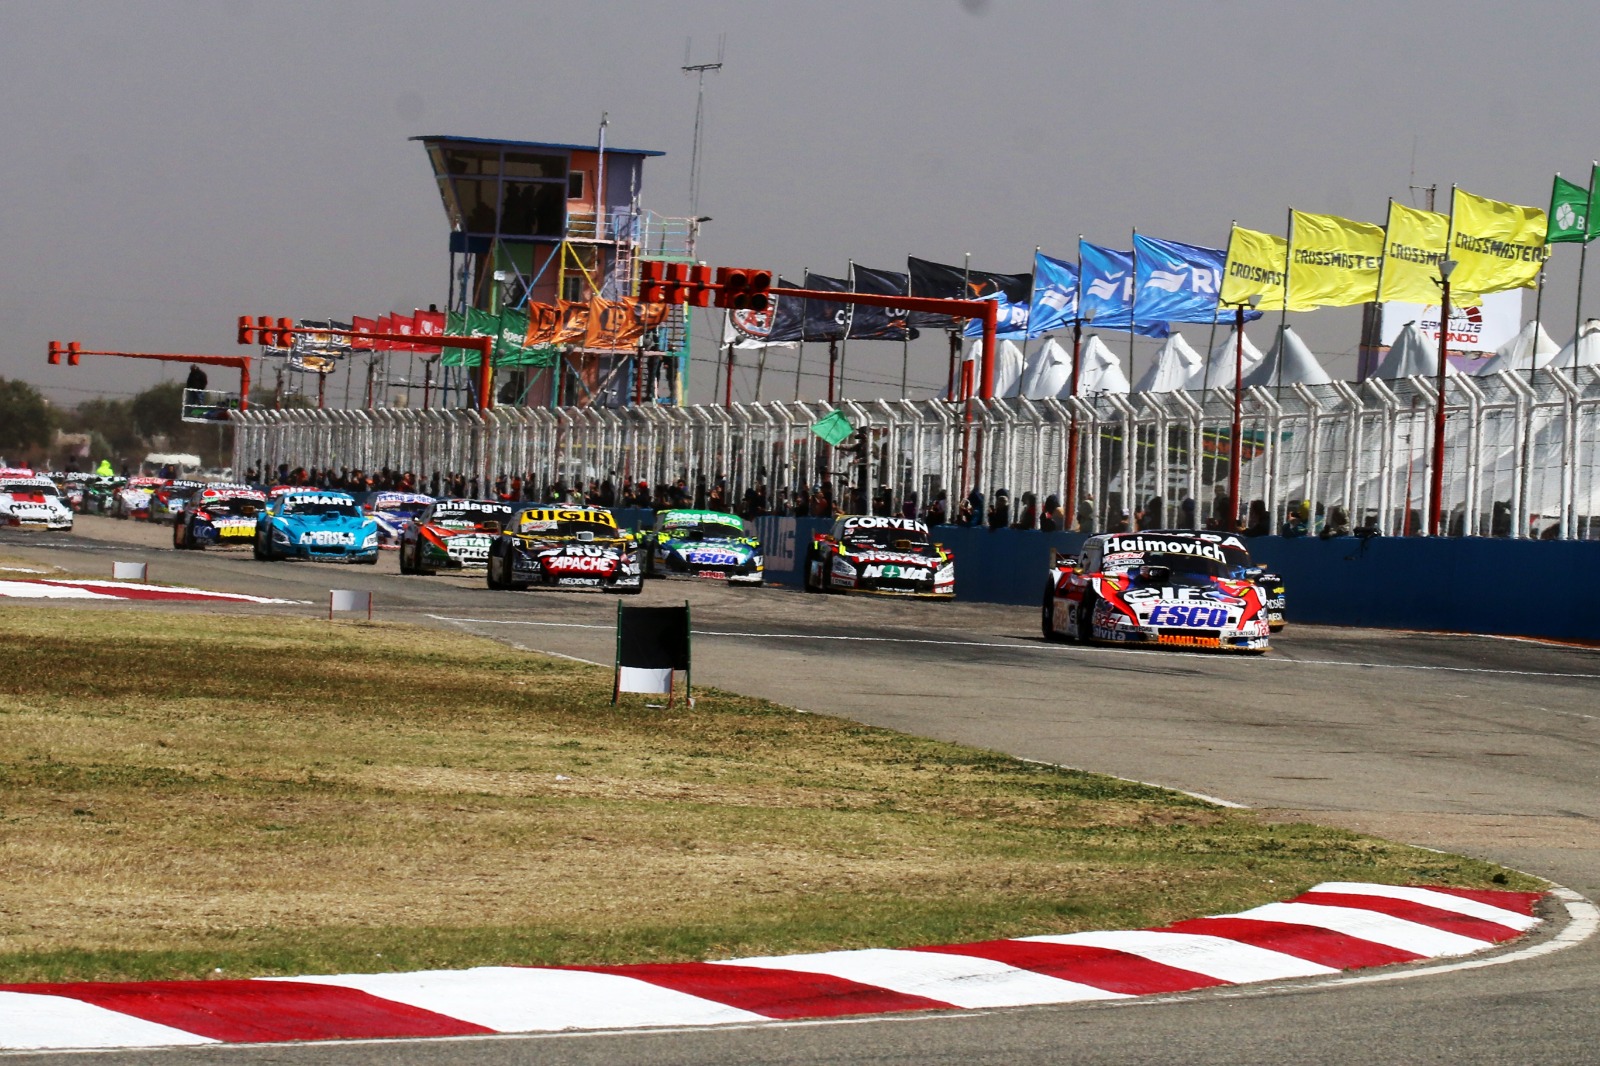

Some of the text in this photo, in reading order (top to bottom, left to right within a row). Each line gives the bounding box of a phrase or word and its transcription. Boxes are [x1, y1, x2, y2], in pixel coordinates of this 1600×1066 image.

[436, 500, 512, 513] philagro
[844, 517, 929, 534] CORVEN
[1103, 536, 1227, 564] Haimovich
[549, 556, 614, 571] APACHE
[1148, 605, 1229, 628] ESCO
[1157, 634, 1221, 647] HAMILTON
